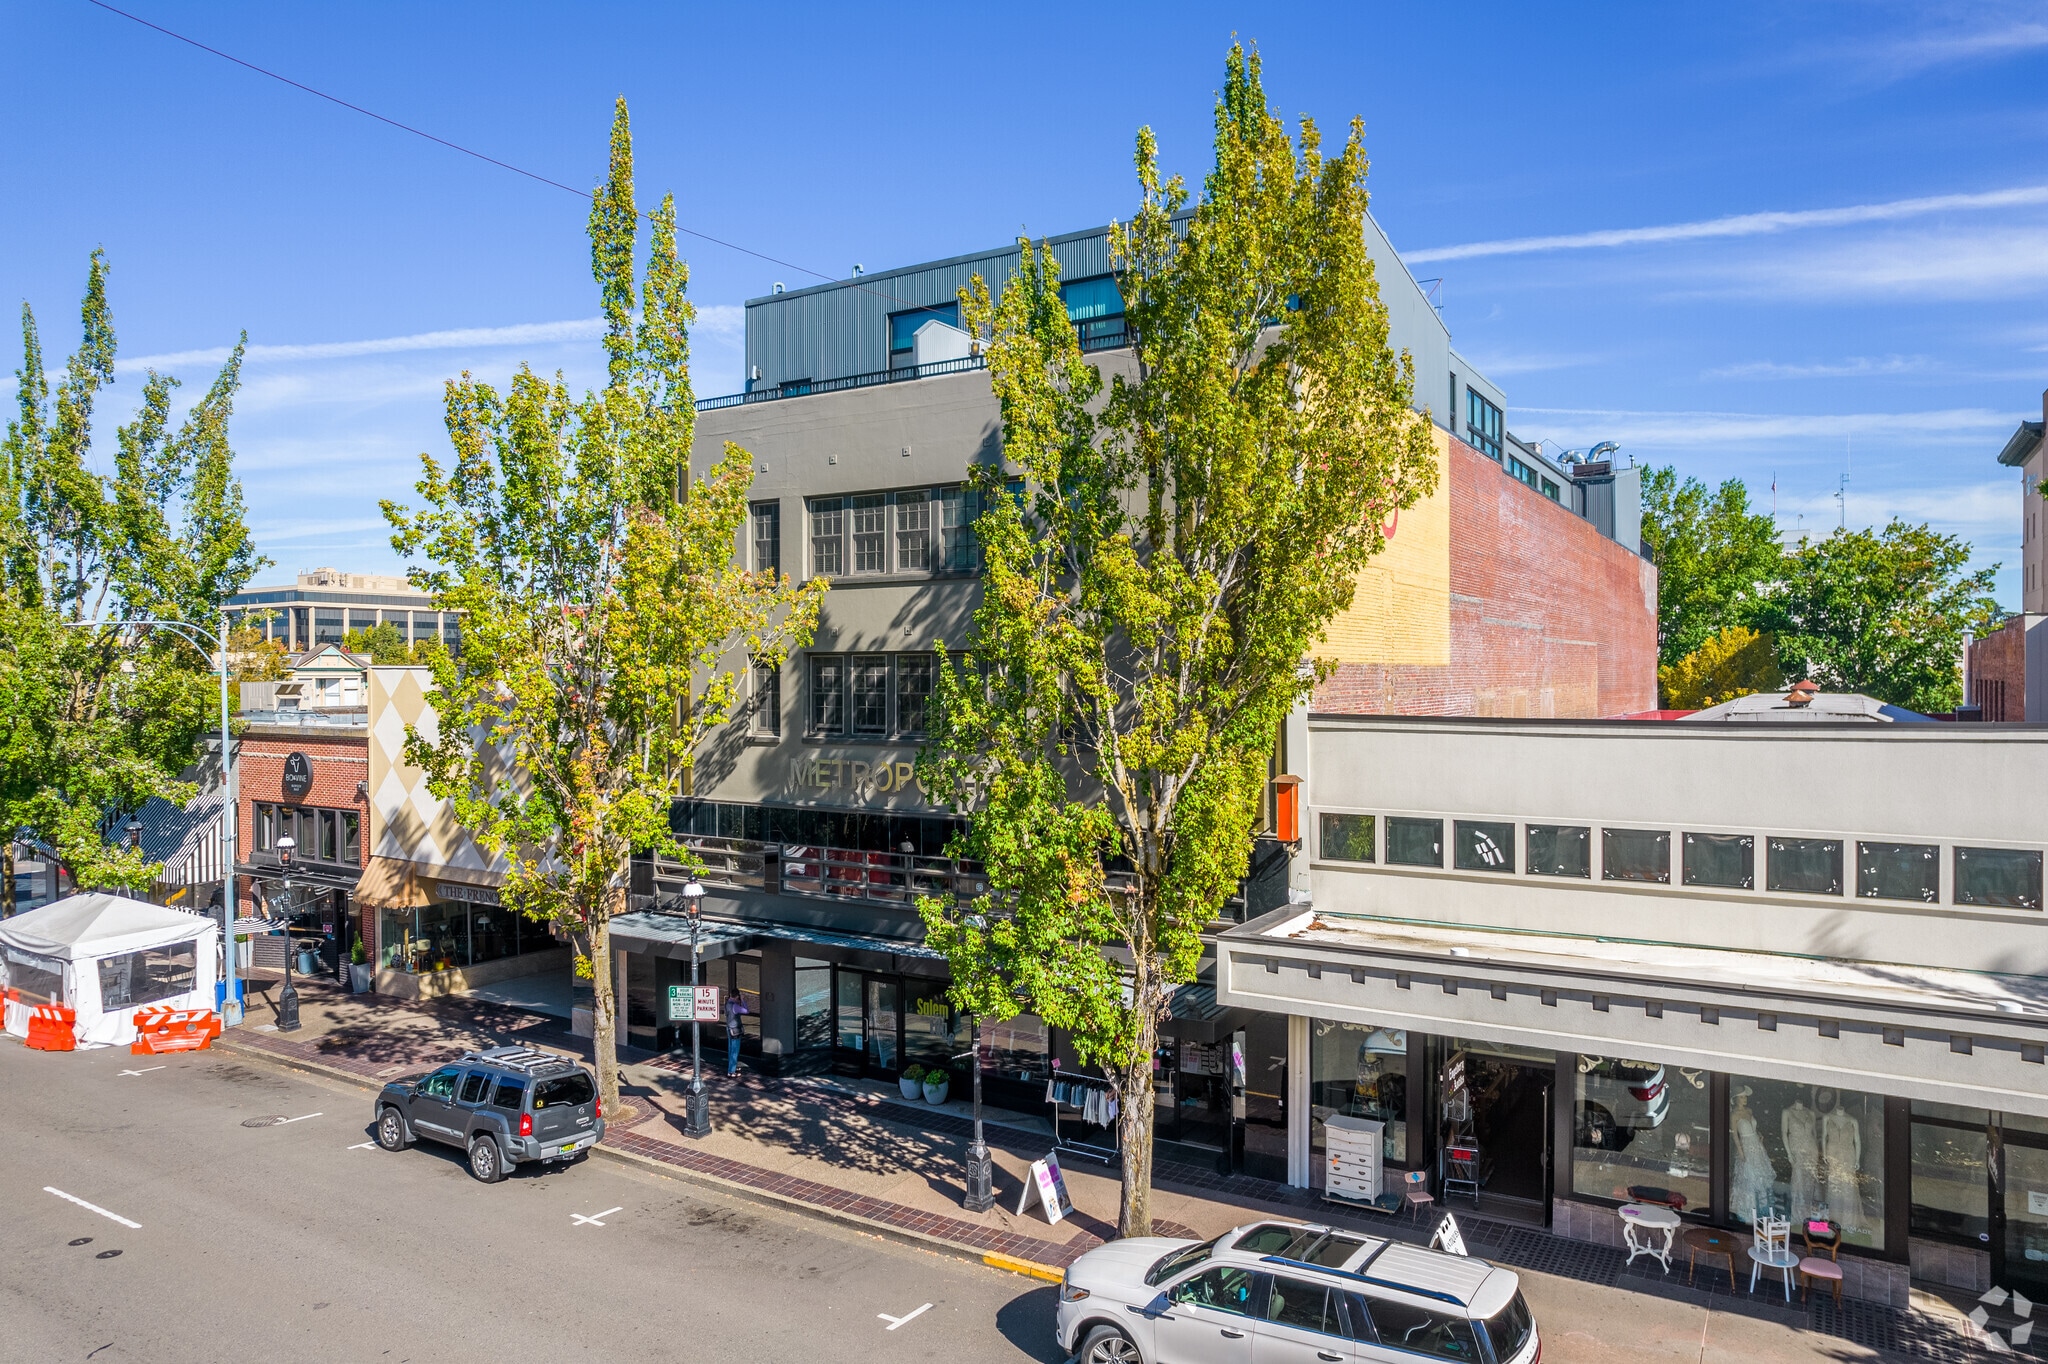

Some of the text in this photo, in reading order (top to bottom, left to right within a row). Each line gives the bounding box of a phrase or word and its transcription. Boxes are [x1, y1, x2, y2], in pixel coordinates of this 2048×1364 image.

[789, 758, 989, 796] METROPIT
[443, 885, 499, 904] THE FRENC
[671, 988, 676, 997] 3
[702, 988, 711, 997] 15
[917, 997, 949, 1020] Salem
